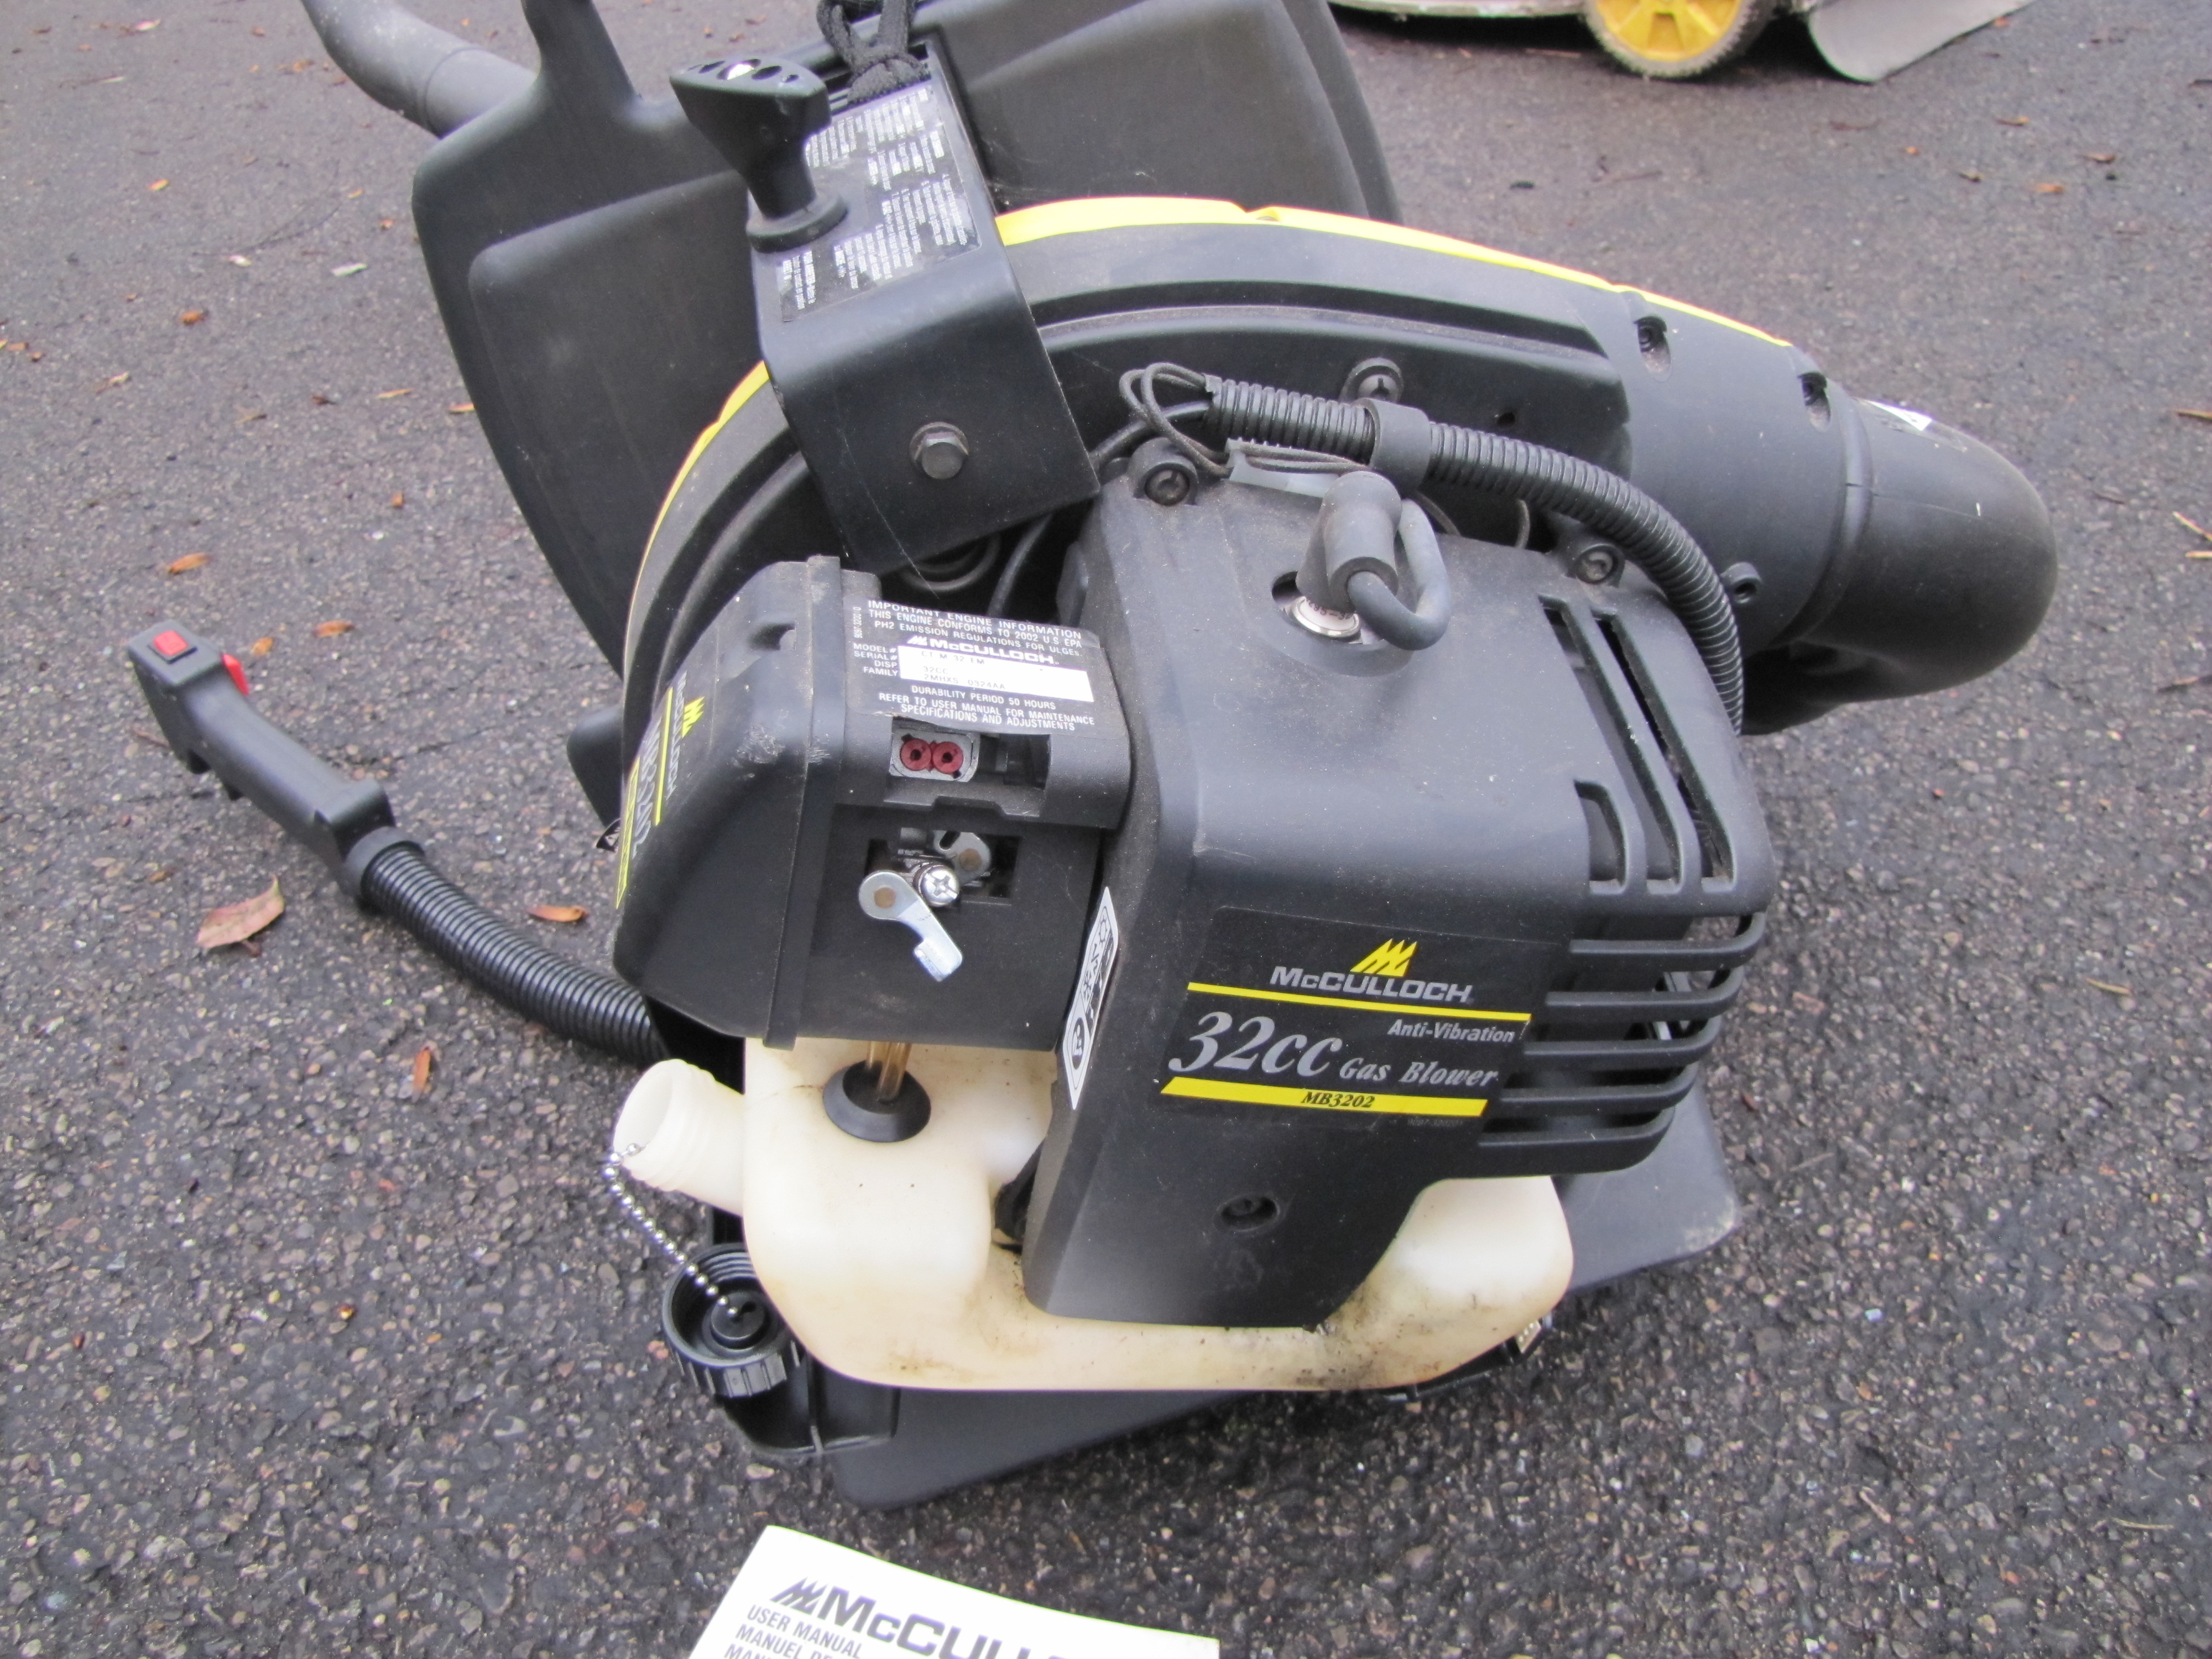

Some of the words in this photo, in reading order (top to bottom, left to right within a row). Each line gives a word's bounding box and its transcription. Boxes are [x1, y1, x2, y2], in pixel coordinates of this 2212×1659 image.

[868, 600, 941, 617] IMPORTANT
[947, 613, 993, 626] ENGINE
[999, 620, 1082, 639] INFORMATION
[869, 609, 891, 619] THIS
[897, 613, 932, 625] ENGINE
[938, 618, 993, 635] CONFORMS
[998, 628, 1010, 638] TO
[1015, 632, 1039, 642] 2002
[1065, 639, 1082, 649] EPA
[874, 620, 895, 629] PH2
[900, 623, 948, 637] EMISSION
[953, 631, 1021, 648] REGULATIONS
[1026, 642, 1045, 651] FOR
[930, 638, 1055, 665] McCULLOCH
[863, 666, 899, 677] FAMILY
[923, 666, 948, 675] 32CC
[878, 692, 910, 704] REFER
[914, 697, 927, 706] TO
[931, 700, 957, 709] USER
[962, 703, 1002, 716] MANUAL
[1006, 708, 1025, 717] FOR
[1029, 710, 1095, 726] MAINTENANCE
[911, 685, 966, 700] DURABILITY
[970, 692, 1005, 704] PERIOD
[1009, 697, 1020, 706] 50
[1024, 700, 1056, 710] HOURS
[900, 704, 978, 722] SPECIFICATIONS
[982, 713, 1003, 725] AND
[1006, 717, 1076, 731] ADJUSTMENTS
[1270, 966, 1473, 1003] McCULLOCH
[1387, 1019, 1516, 1043] Anti-Vibration
[1339, 1057, 1391, 1082] Gas
[1398, 1061, 1499, 1087] Blower
[1300, 1091, 1375, 1108] MB3202
[735, 1624, 804, 1659] MANUEL
[747, 1604, 791, 1632] USER
[792, 1621, 863, 1659] MANUAL
